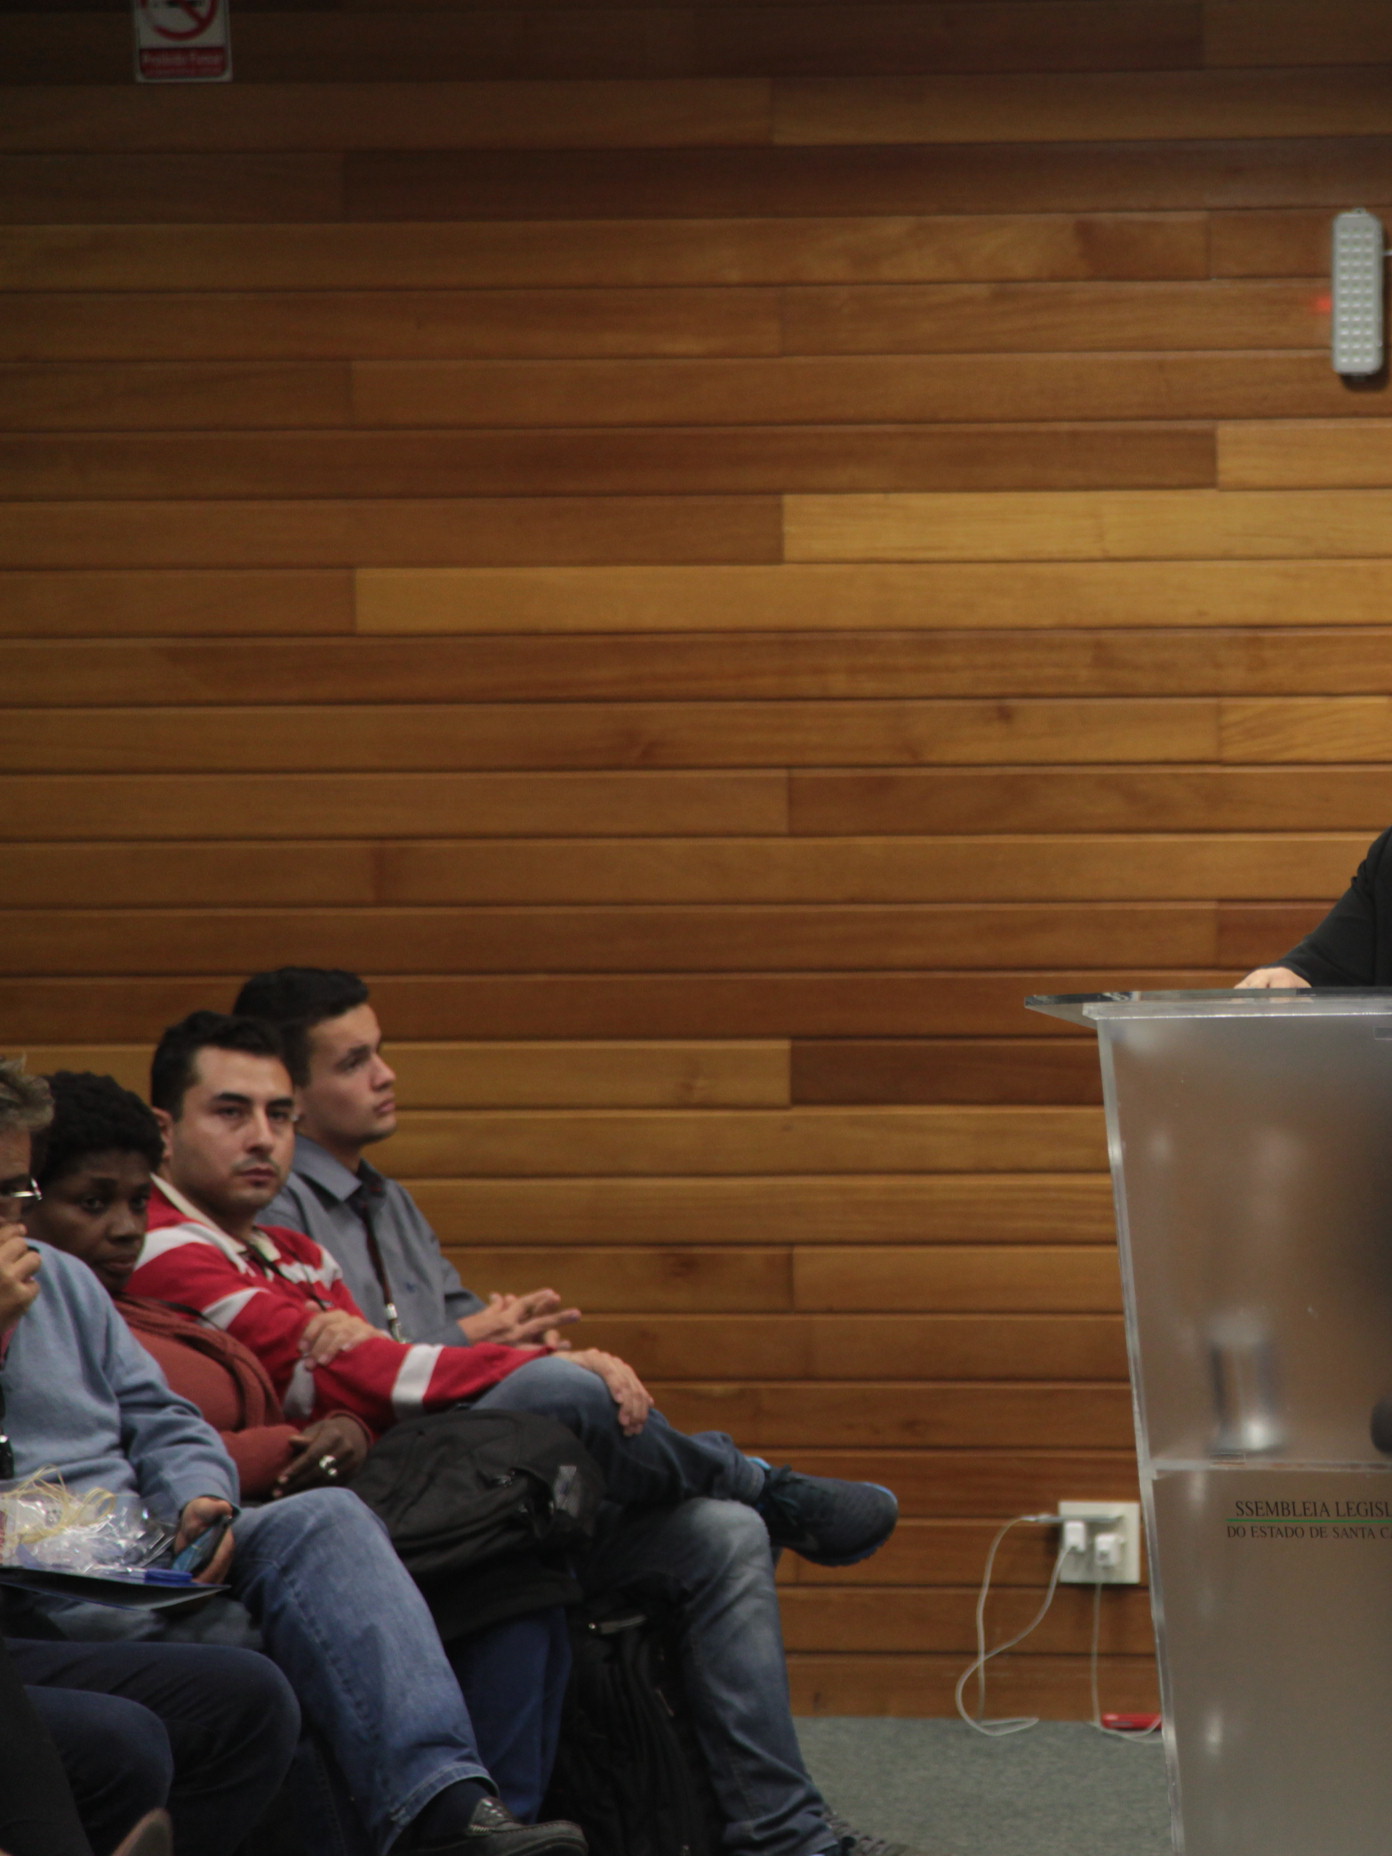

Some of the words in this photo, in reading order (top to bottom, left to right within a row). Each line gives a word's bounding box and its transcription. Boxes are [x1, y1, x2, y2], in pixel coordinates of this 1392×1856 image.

[1227, 1525, 1246, 1539] DO
[1251, 1525, 1305, 1539] ESTADO
[1309, 1525, 1328, 1539] DE
[1332, 1525, 1376, 1540] SANTA
